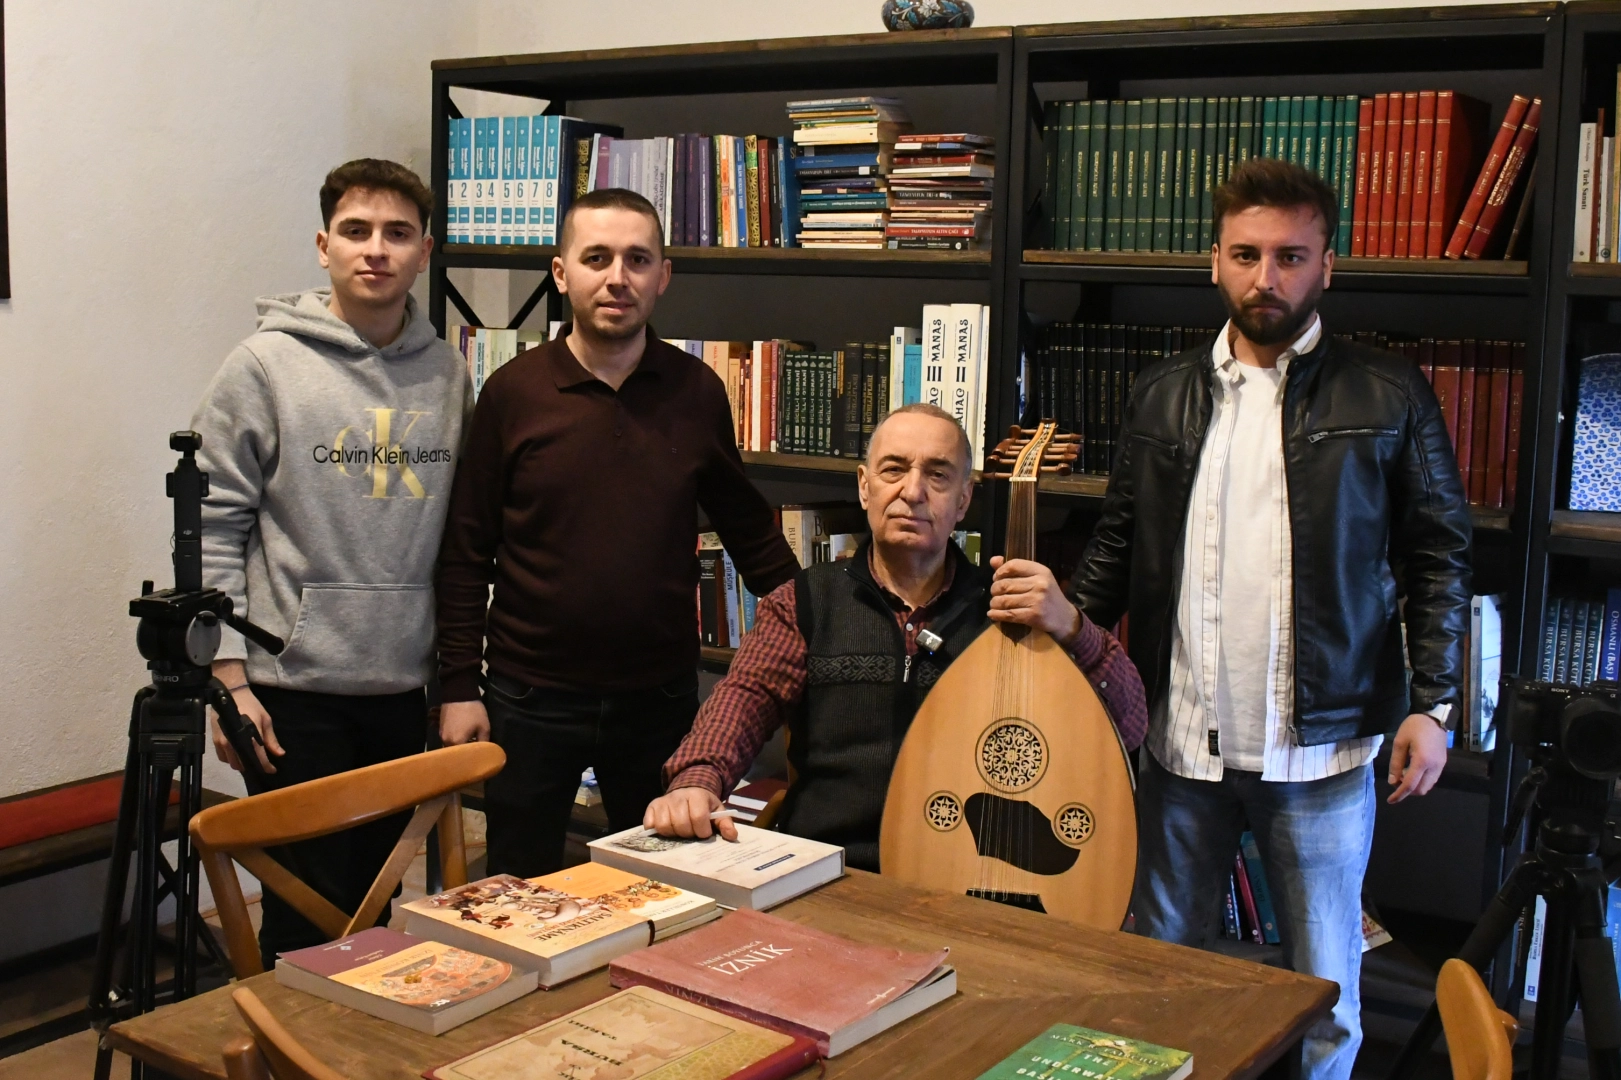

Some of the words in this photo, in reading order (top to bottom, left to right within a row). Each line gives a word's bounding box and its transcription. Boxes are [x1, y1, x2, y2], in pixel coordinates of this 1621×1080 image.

[1582, 168, 1590, 187] Türk
[449, 182, 454, 198] 1
[461, 182, 468, 198] 2
[476, 182, 483, 198] 3
[488, 182, 495, 198] 4
[504, 182, 510, 198] 5
[516, 182, 524, 198] 6
[532, 182, 539, 198] 7
[545, 182, 553, 198] 8
[931, 318, 942, 363] MANAS
[957, 318, 969, 363] MANAS
[313, 445, 368, 464] Calvin
[372, 446, 410, 465] Klein
[412, 446, 451, 464] Jeans
[788, 526, 797, 556] BURS
[725, 561, 735, 591] MÜŞKÜLE
[1544, 626, 1554, 655] BURSA
[1608, 610, 1620, 651] OSMANLI
[1557, 627, 1568, 657] BURSA
[1572, 629, 1583, 659] BURSA
[1586, 630, 1597, 660] BURSA
[707, 943, 794, 976] İZNİK
[1052, 1034, 1083, 1046] MARK
[561, 1039, 623, 1067] BURSA
[1084, 1053, 1112, 1066] THE
[1031, 1055, 1122, 1080] UNDERWAT
